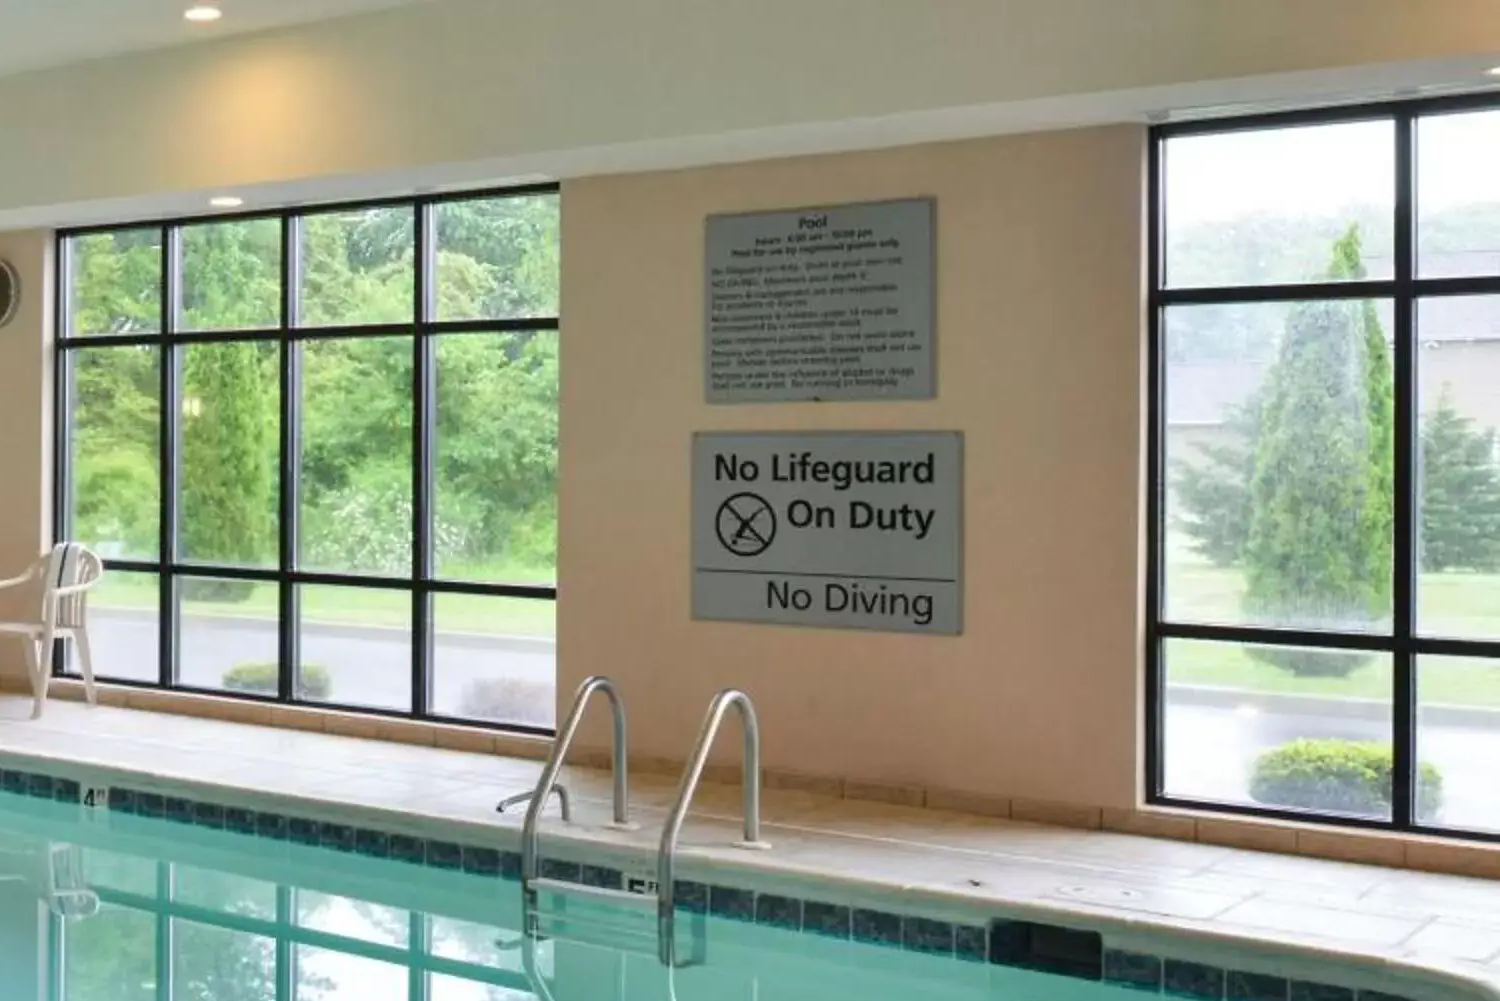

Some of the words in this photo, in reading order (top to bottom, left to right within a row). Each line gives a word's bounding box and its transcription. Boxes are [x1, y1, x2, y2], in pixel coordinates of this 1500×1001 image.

[798, 214, 828, 230] Pool
[715, 454, 759, 482] No
[772, 452, 934, 491] Lifeguard
[787, 499, 835, 528] On
[849, 501, 935, 540] Duty
[767, 580, 812, 611] No
[825, 583, 933, 625] Diving
